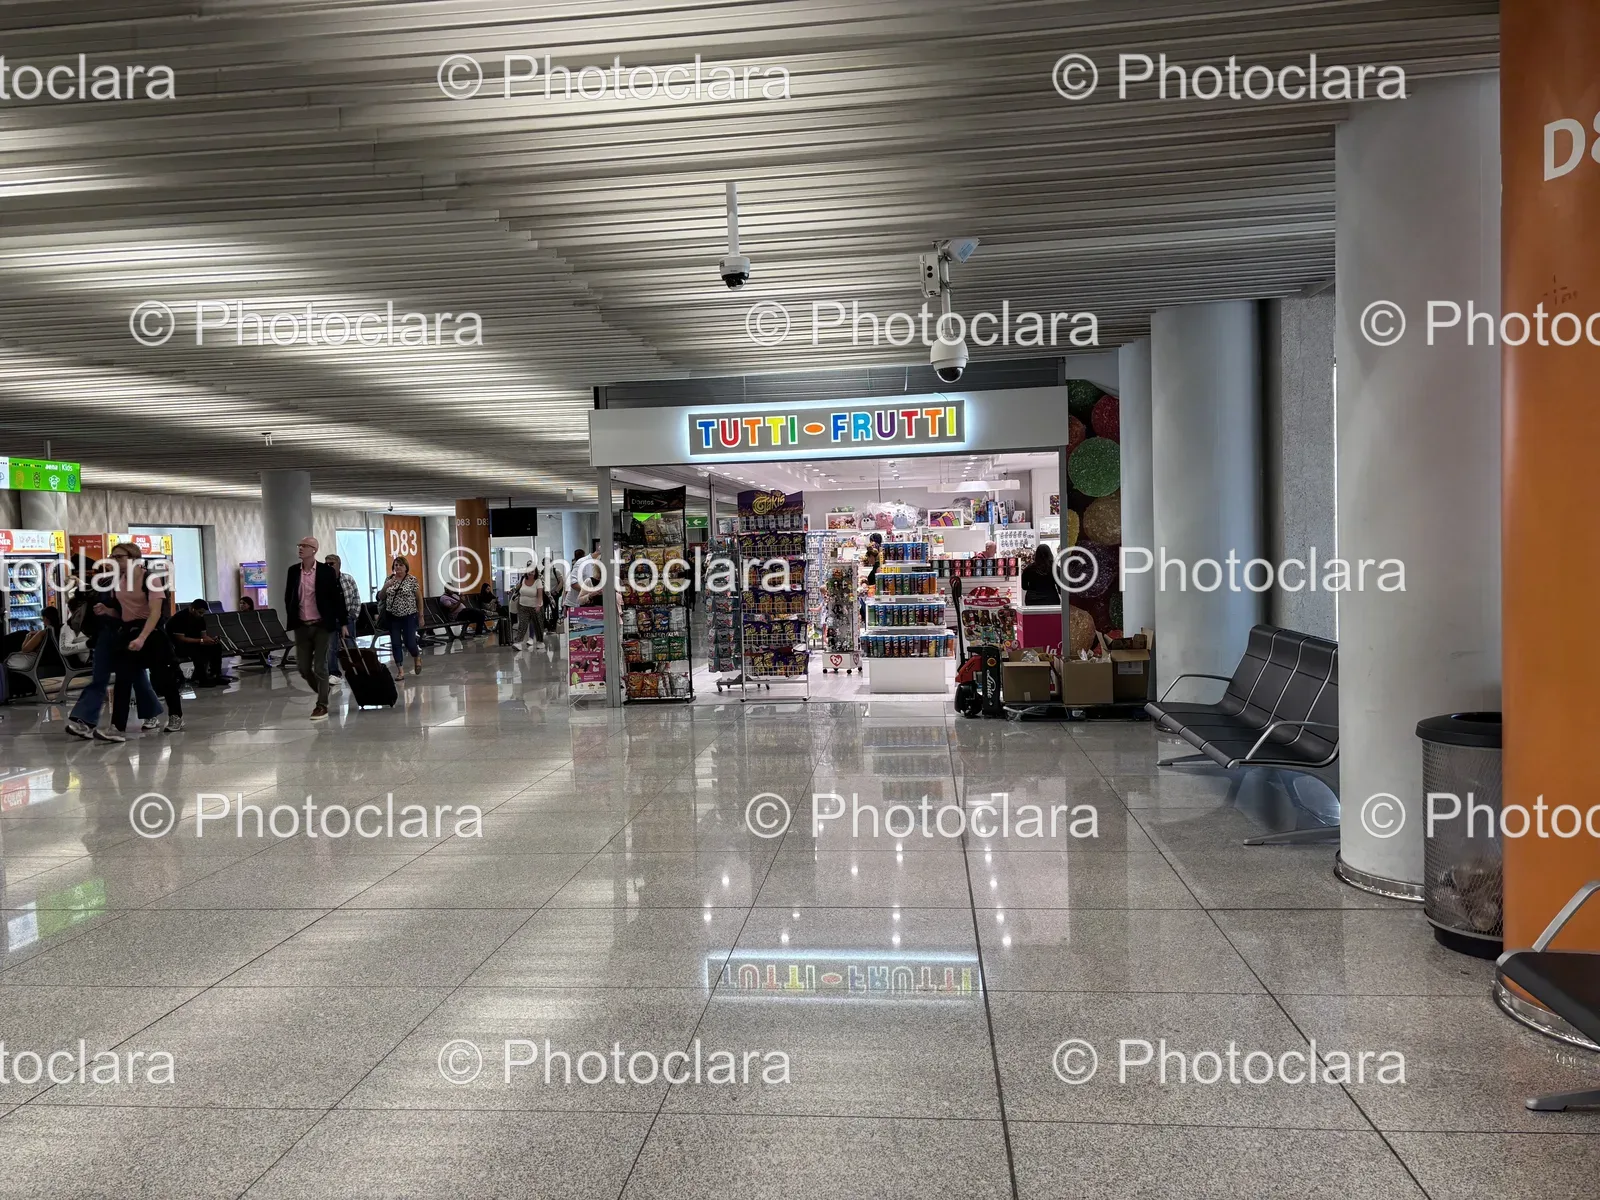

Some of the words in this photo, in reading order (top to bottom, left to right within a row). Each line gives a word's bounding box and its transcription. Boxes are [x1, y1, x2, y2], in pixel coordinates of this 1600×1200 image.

[1544, 111, 1600, 181] D
[696, 414, 798, 448] TUTTI
[831, 406, 958, 443] FRUTTI
[61, 463, 73, 472] Kids
[389, 529, 418, 557] D83
[986, 669, 997, 698] Linde
